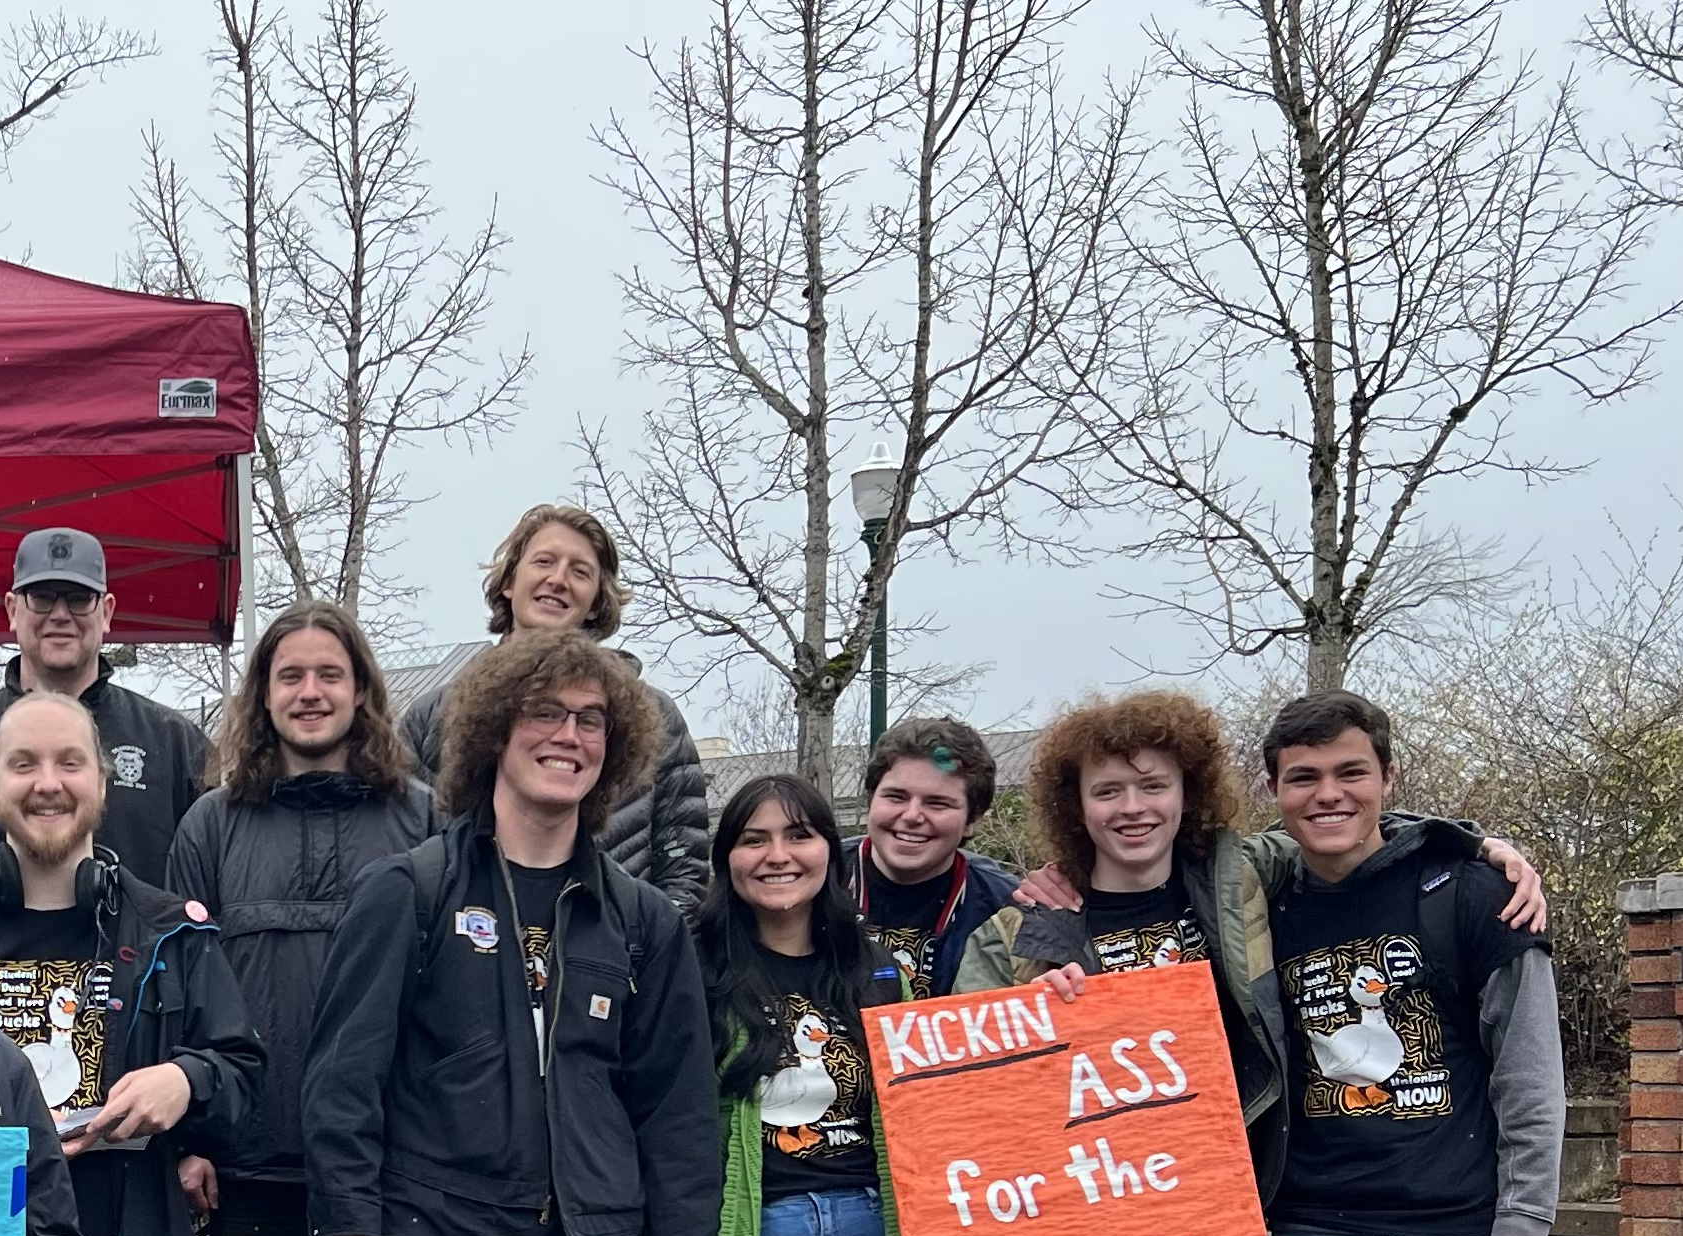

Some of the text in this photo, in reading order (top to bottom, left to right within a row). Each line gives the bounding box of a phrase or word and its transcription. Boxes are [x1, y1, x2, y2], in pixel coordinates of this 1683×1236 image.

[162, 393, 210, 409] Eurmax
[1315, 986, 1344, 998] More
[1300, 1000, 1347, 1020] Bucks
[1069, 1030, 1189, 1118] ASS
[1390, 1072, 1445, 1087] Unionize
[1396, 1086, 1442, 1107] NOW
[947, 1138, 1178, 1227] for the
